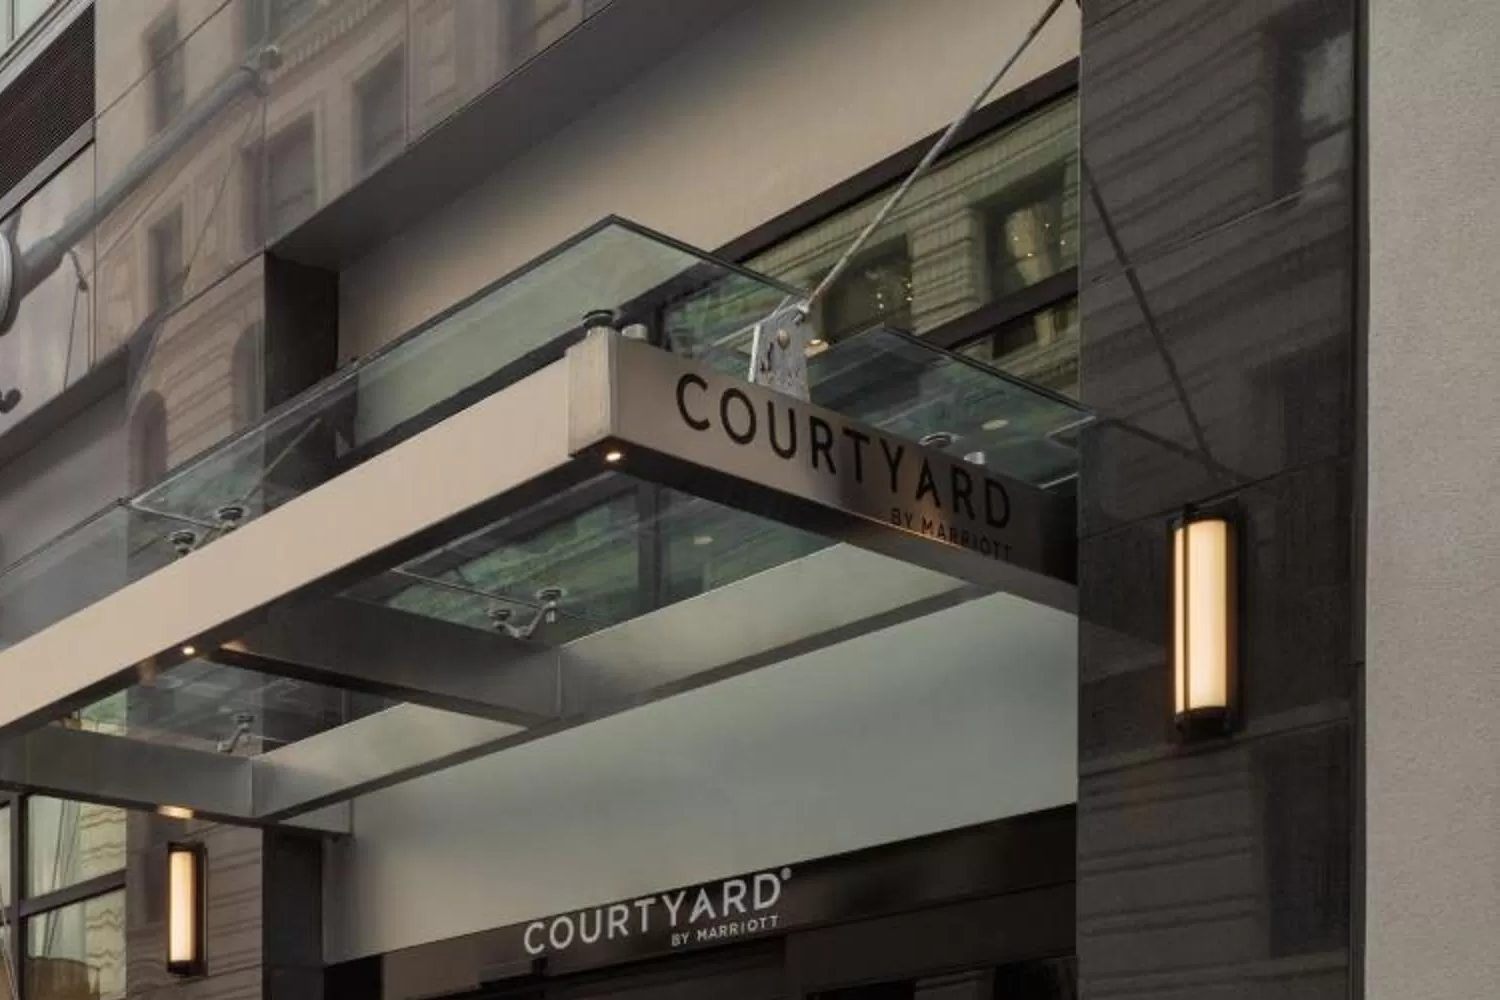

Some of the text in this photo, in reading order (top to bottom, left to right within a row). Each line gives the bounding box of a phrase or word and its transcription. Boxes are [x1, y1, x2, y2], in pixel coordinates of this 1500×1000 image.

[675, 372, 1011, 529] COURTYARD
[890, 507, 1013, 561] BY MARRIOTT
[523, 872, 783, 955] COURTYARD
[671, 915, 780, 947] BY MARRIOTT
